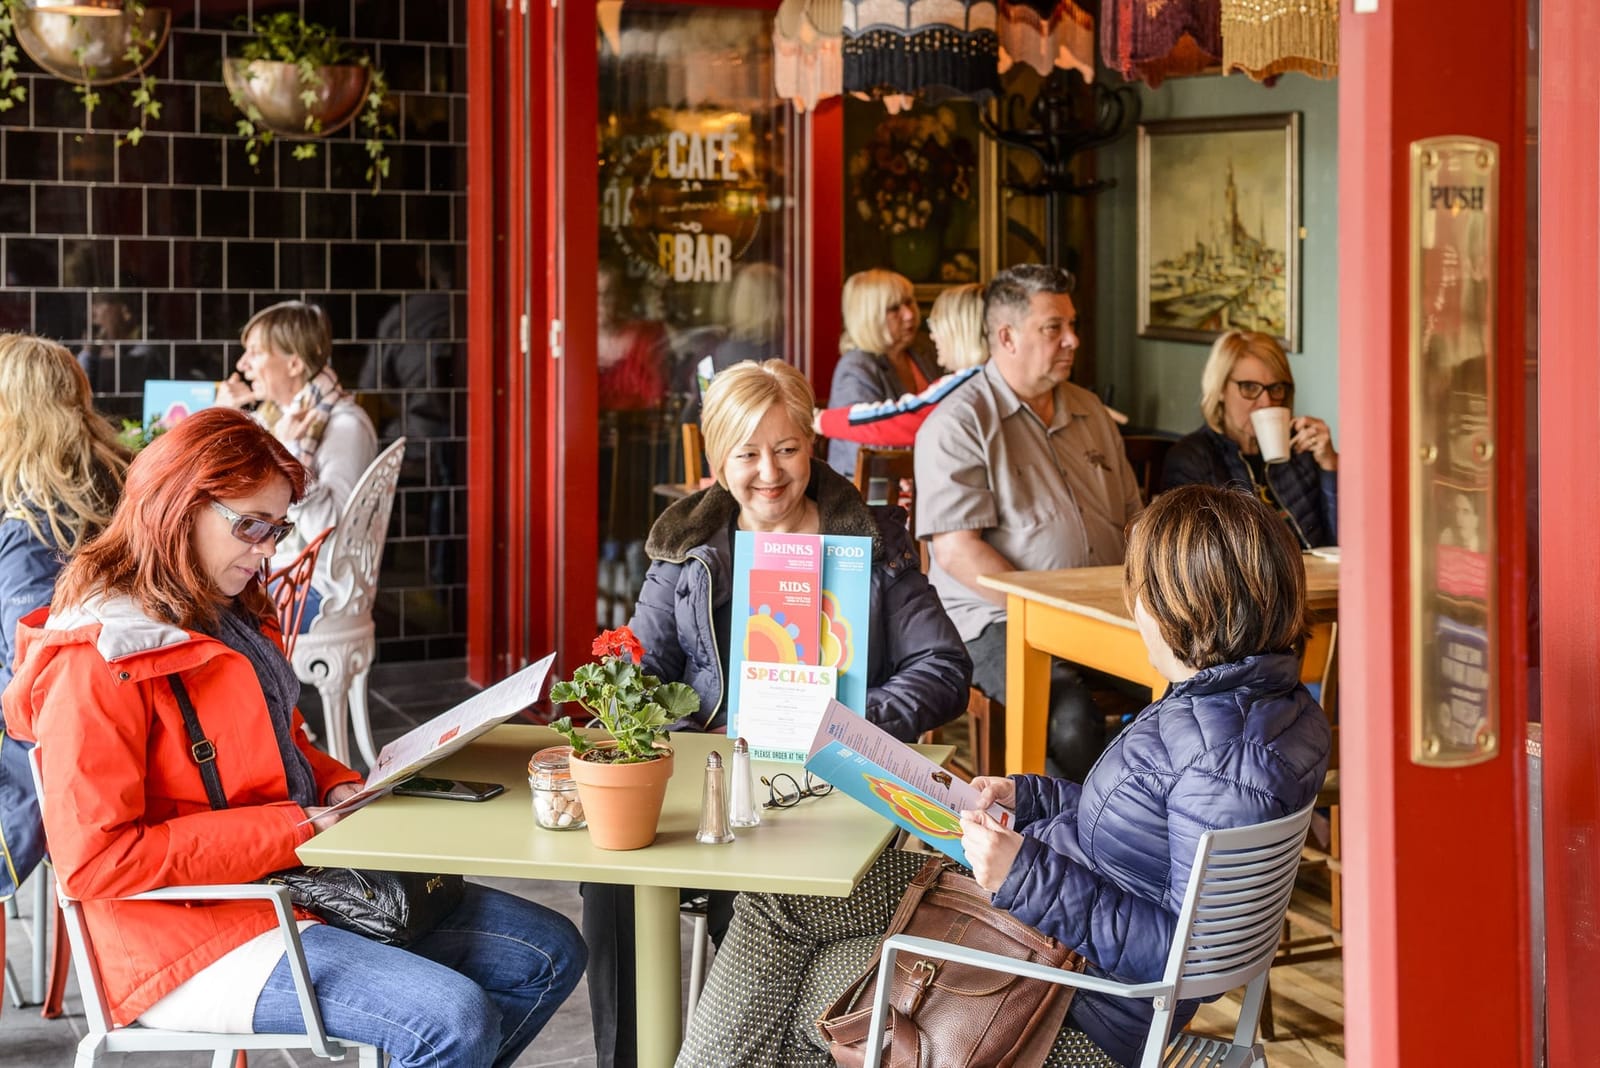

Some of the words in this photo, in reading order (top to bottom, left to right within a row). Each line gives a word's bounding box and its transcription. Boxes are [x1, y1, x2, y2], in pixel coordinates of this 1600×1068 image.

[668, 125, 739, 180] CAFÉ
[1430, 186, 1484, 209] PUSH
[675, 233, 732, 283] BAR
[764, 542, 813, 556] DRINKS
[827, 546, 864, 557] FOOD
[779, 581, 811, 593] KIDS
[747, 667, 830, 685] SPECIALS
[754, 749, 771, 759] PLEASE
[772, 751, 787, 760] ORDER
[788, 752, 795, 760] AT
[795, 752, 805, 761] THE
